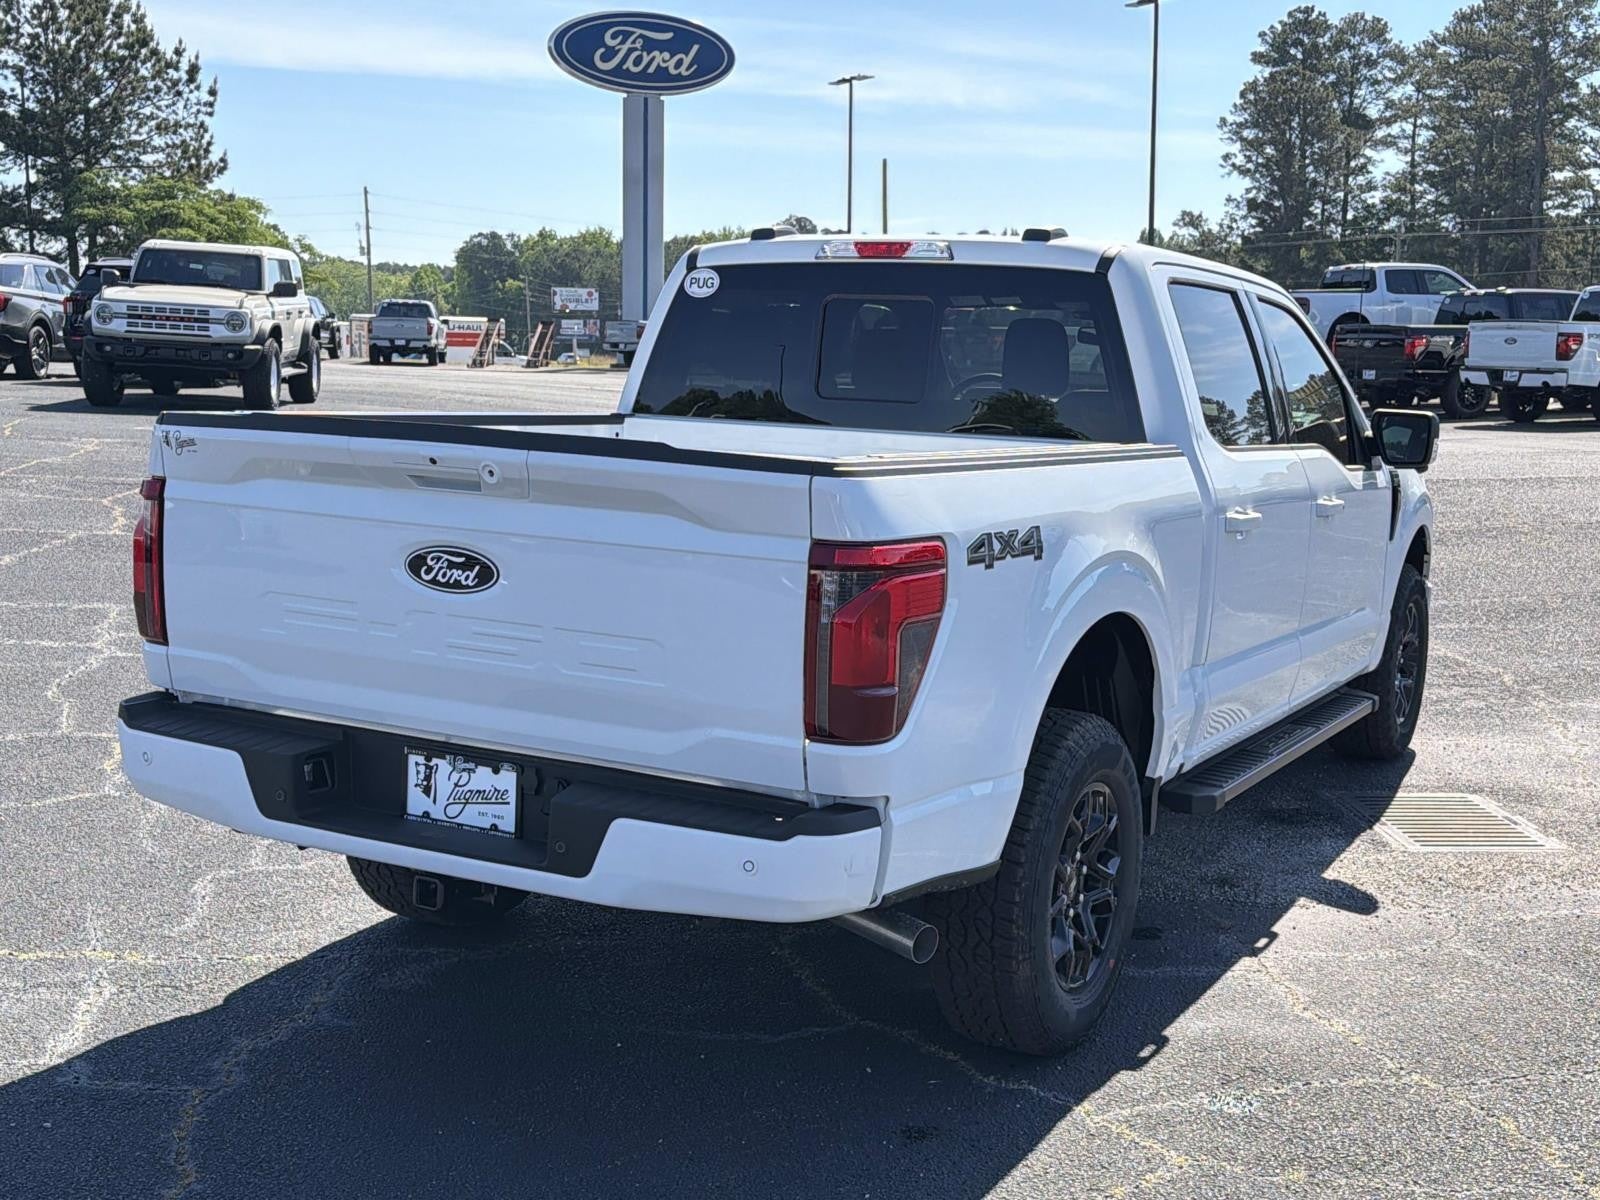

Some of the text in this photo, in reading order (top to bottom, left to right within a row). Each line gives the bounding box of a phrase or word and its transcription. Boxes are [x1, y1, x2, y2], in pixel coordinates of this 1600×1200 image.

[593, 26, 700, 77] Ford
[689, 276, 715, 289] PUG
[420, 552, 481, 587] Ford
[444, 770, 510, 819] Pugmire
